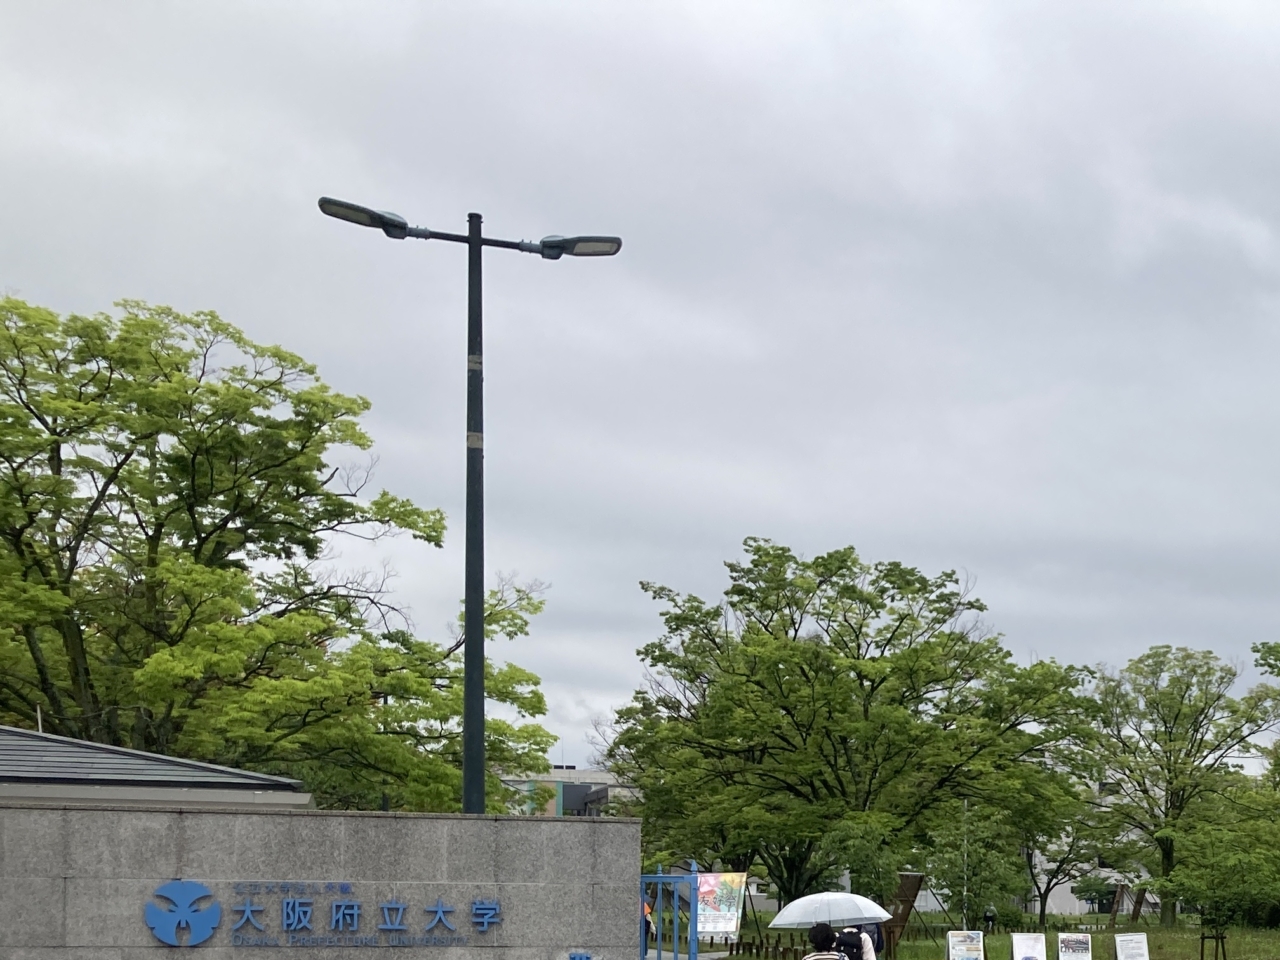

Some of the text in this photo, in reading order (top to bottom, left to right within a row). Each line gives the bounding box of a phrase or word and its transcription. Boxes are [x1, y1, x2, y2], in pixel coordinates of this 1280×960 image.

[231, 897, 501, 931] 大阪府立大学
[289, 933, 379, 946] PREFECTURE
